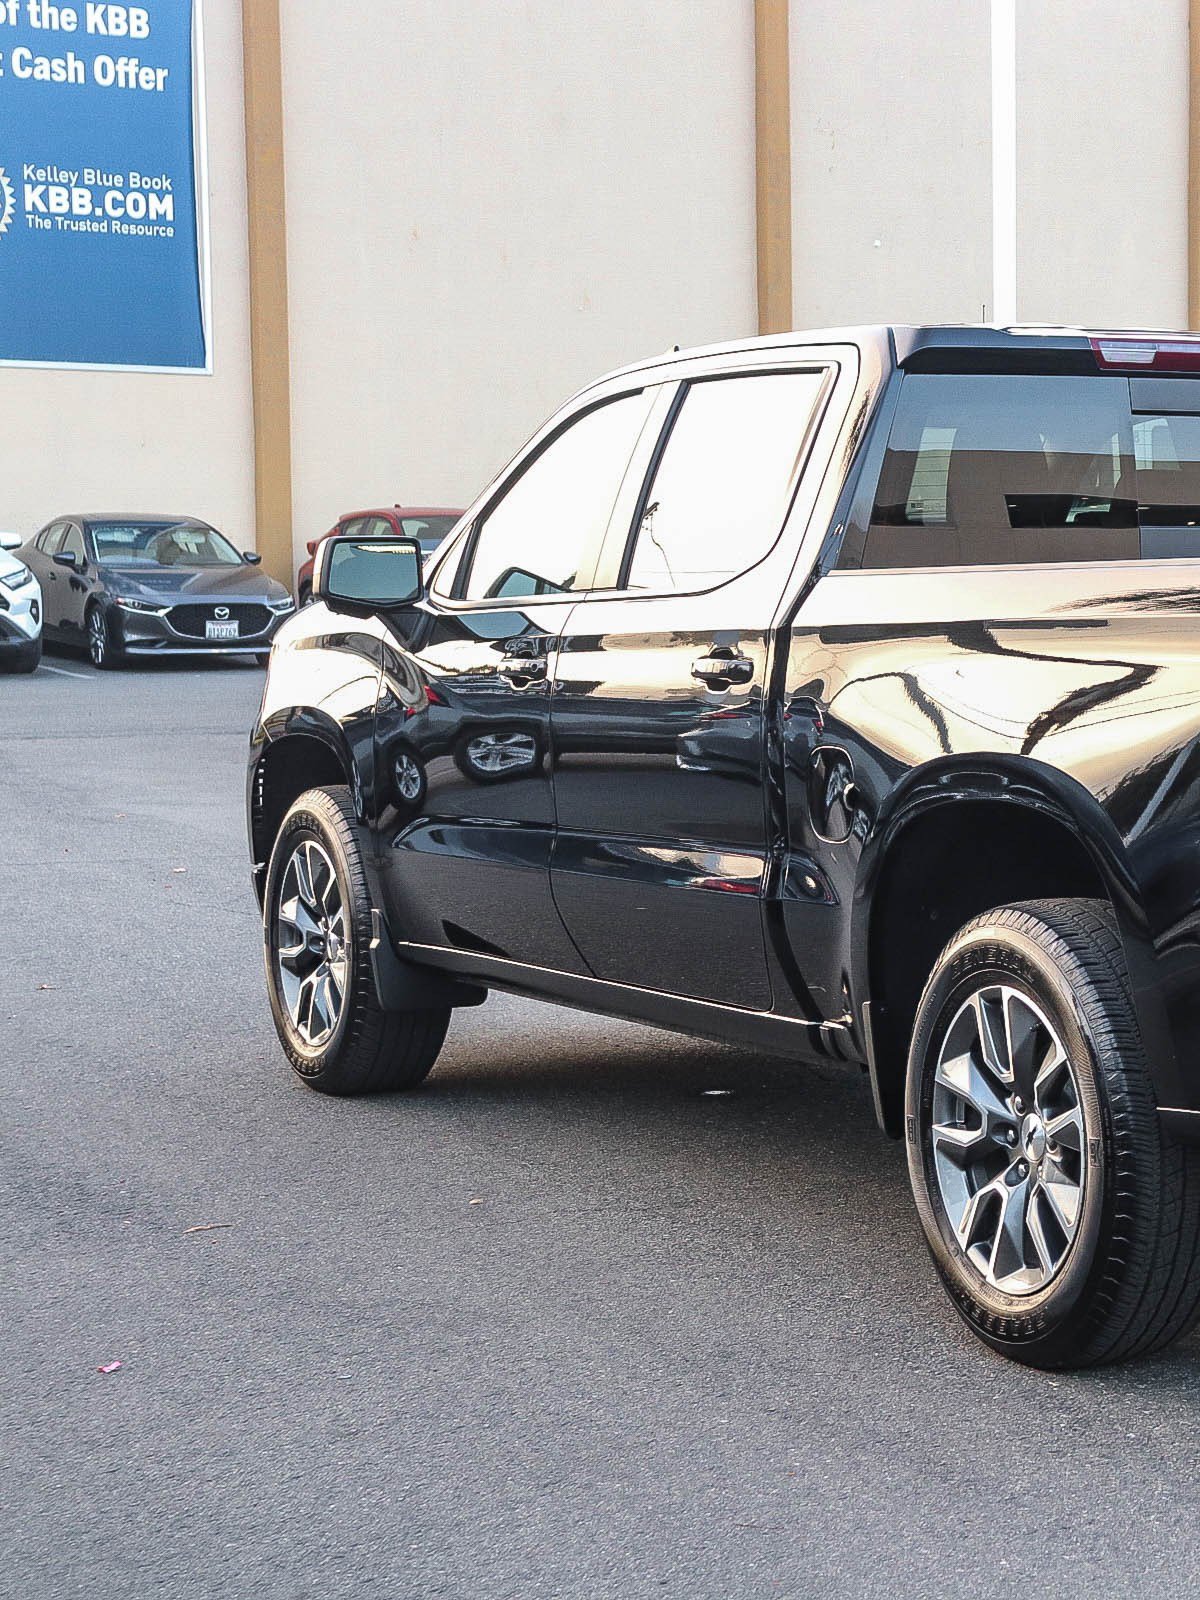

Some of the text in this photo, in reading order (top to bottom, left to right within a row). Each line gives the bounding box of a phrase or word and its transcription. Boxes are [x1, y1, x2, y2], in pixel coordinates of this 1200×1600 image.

[27, 0, 78, 32] the
[86, 2, 150, 39] KBB
[12, 46, 85, 84] Cash
[94, 55, 169, 91] Offer
[23, 164, 173, 191] Kelley Blue Book
[24, 183, 175, 222] KBB.COM
[26, 215, 175, 238] The Trusted Resource
